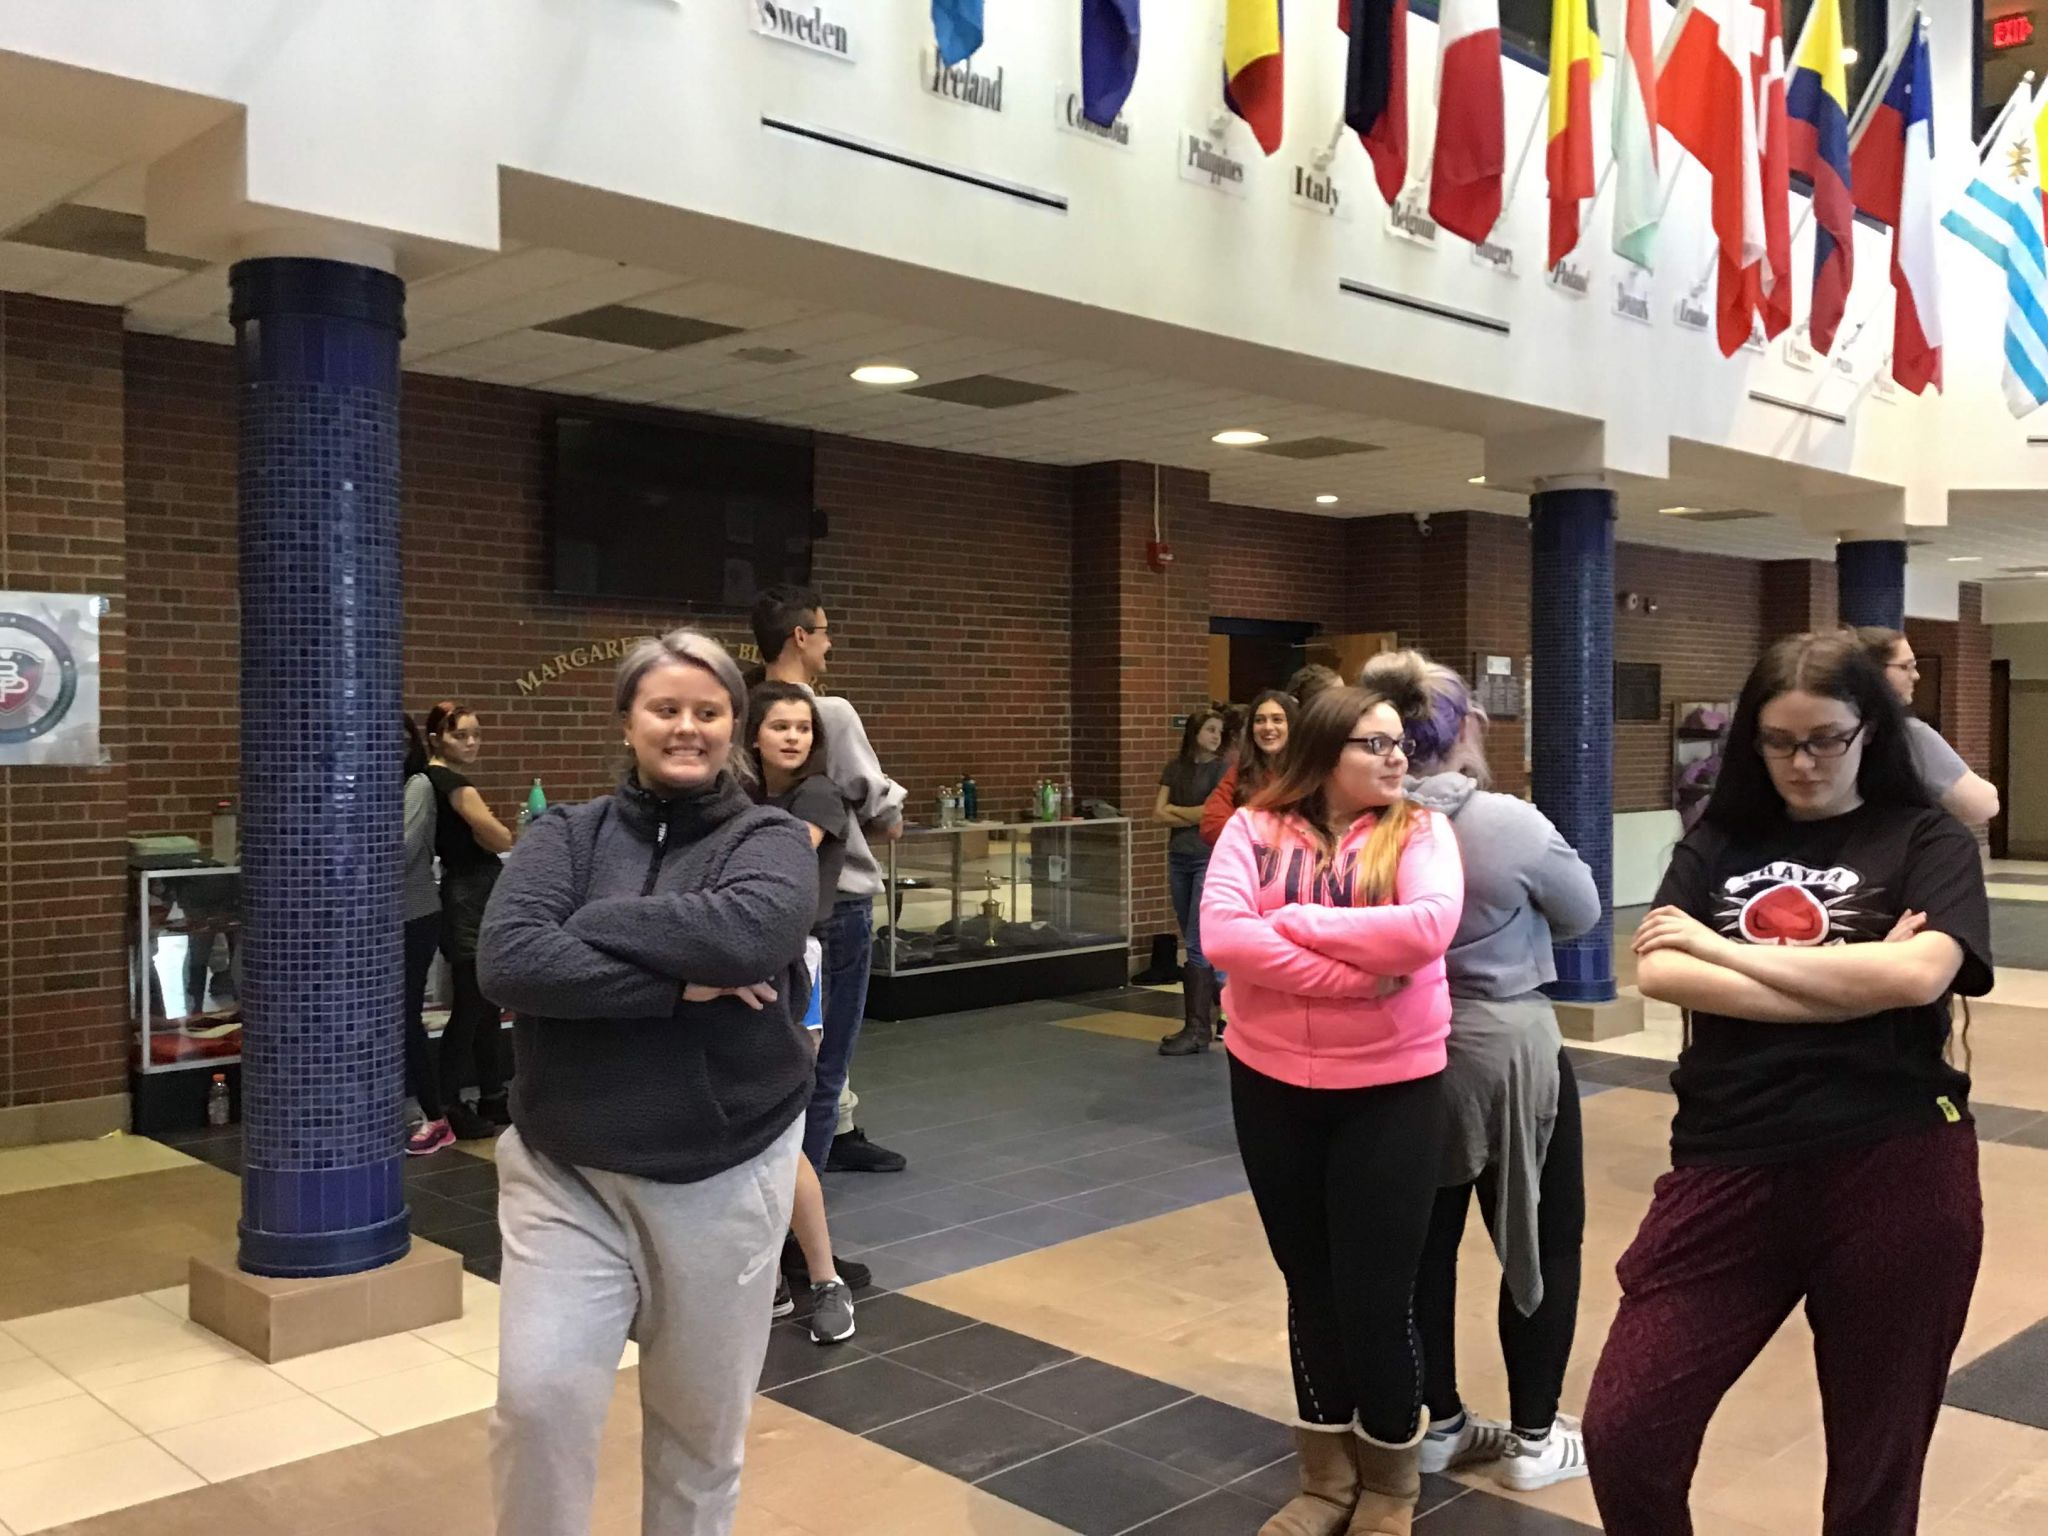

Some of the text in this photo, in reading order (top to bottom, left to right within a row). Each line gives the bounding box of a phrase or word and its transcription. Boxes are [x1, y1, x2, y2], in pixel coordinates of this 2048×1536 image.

[760, 0, 848, 54] Sweden
[1295, 165, 1340, 216] Italy
[515, 636, 642, 697] MARGARE
[1252, 842, 1398, 908] PIN
